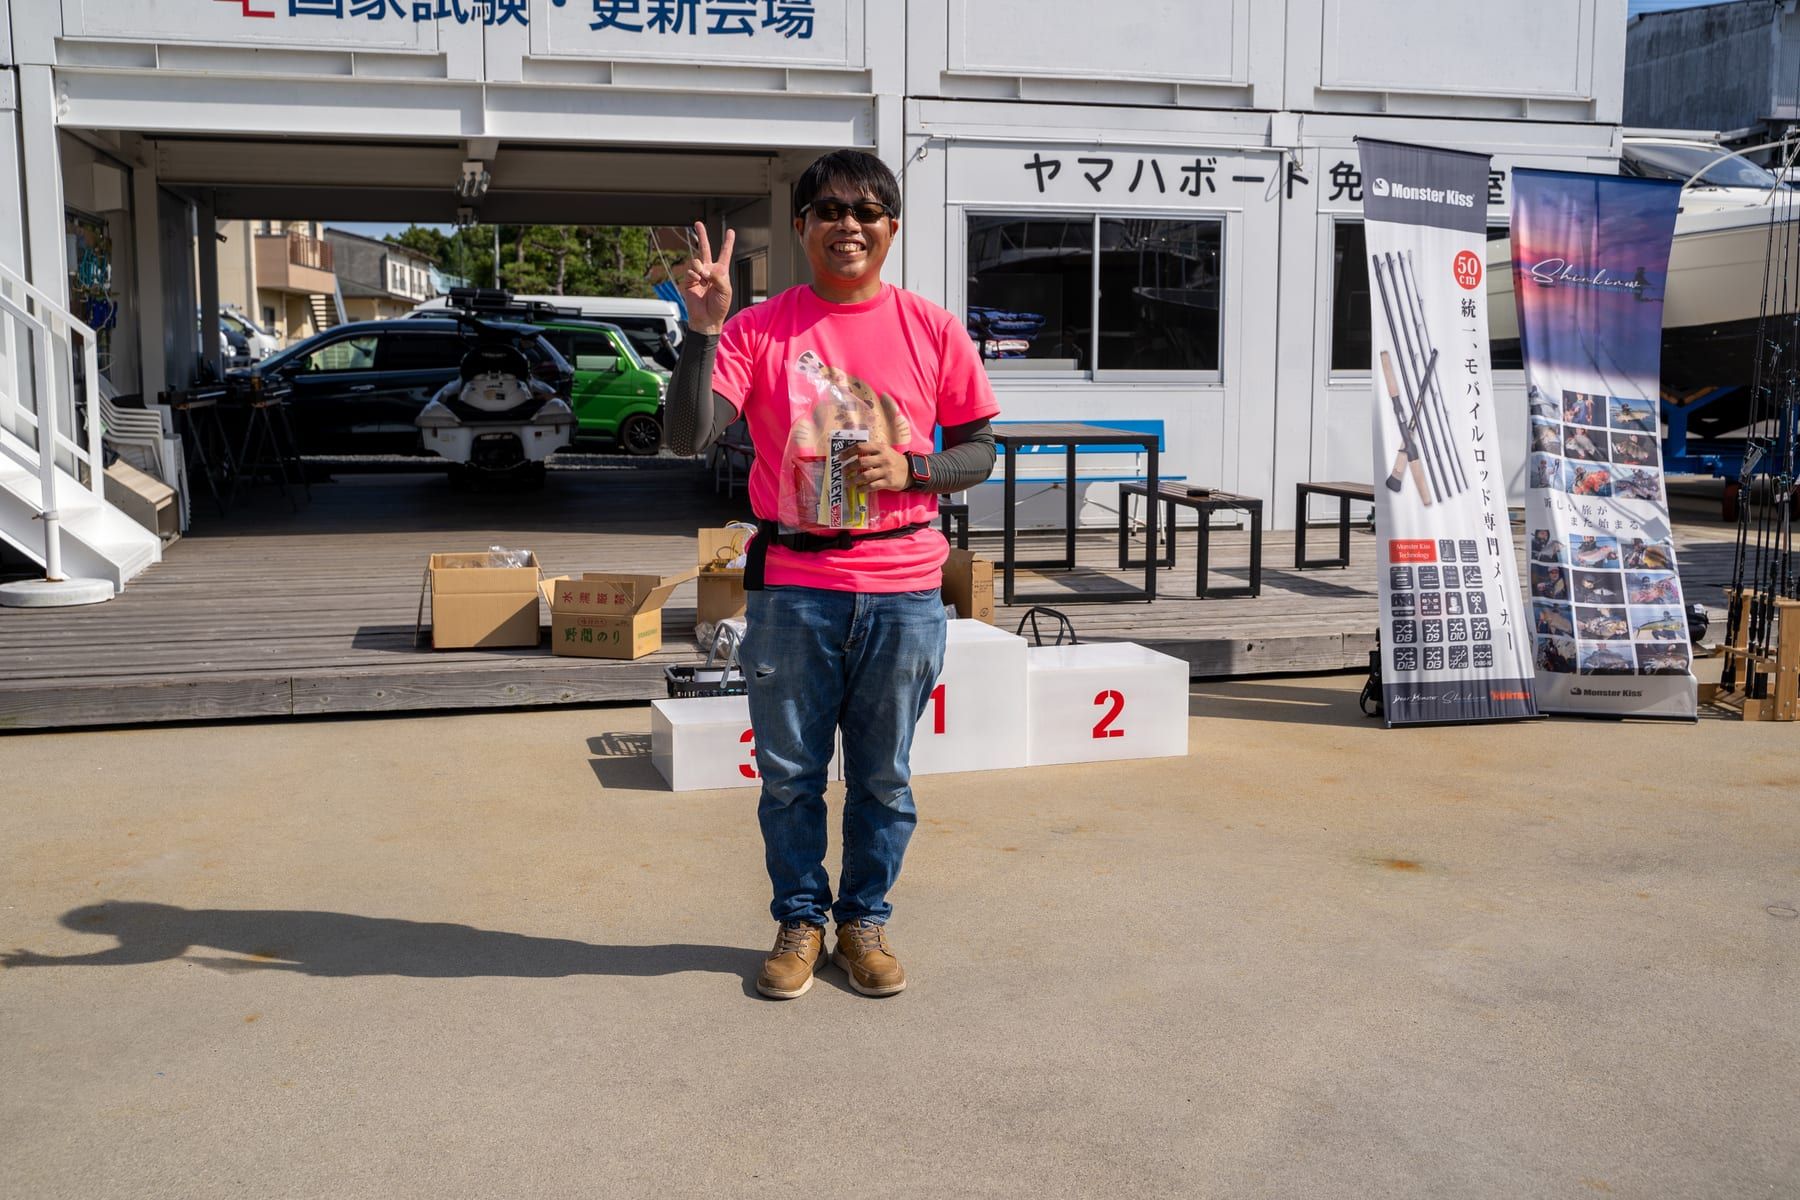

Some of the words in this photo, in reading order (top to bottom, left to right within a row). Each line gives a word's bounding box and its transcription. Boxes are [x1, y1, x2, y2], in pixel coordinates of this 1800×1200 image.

[1391, 183, 1443, 204] Monster
[1446, 190, 1474, 207] Kiss
[1457, 256, 1478, 275] 50
[1459, 275, 1476, 286] cm
[1571, 517, 1640, 530] また始まる
[1583, 688, 1621, 697] Monster
[1622, 689, 1642, 697] Kiss
[929, 684, 945, 734] 1
[1092, 689, 1125, 738] 2
